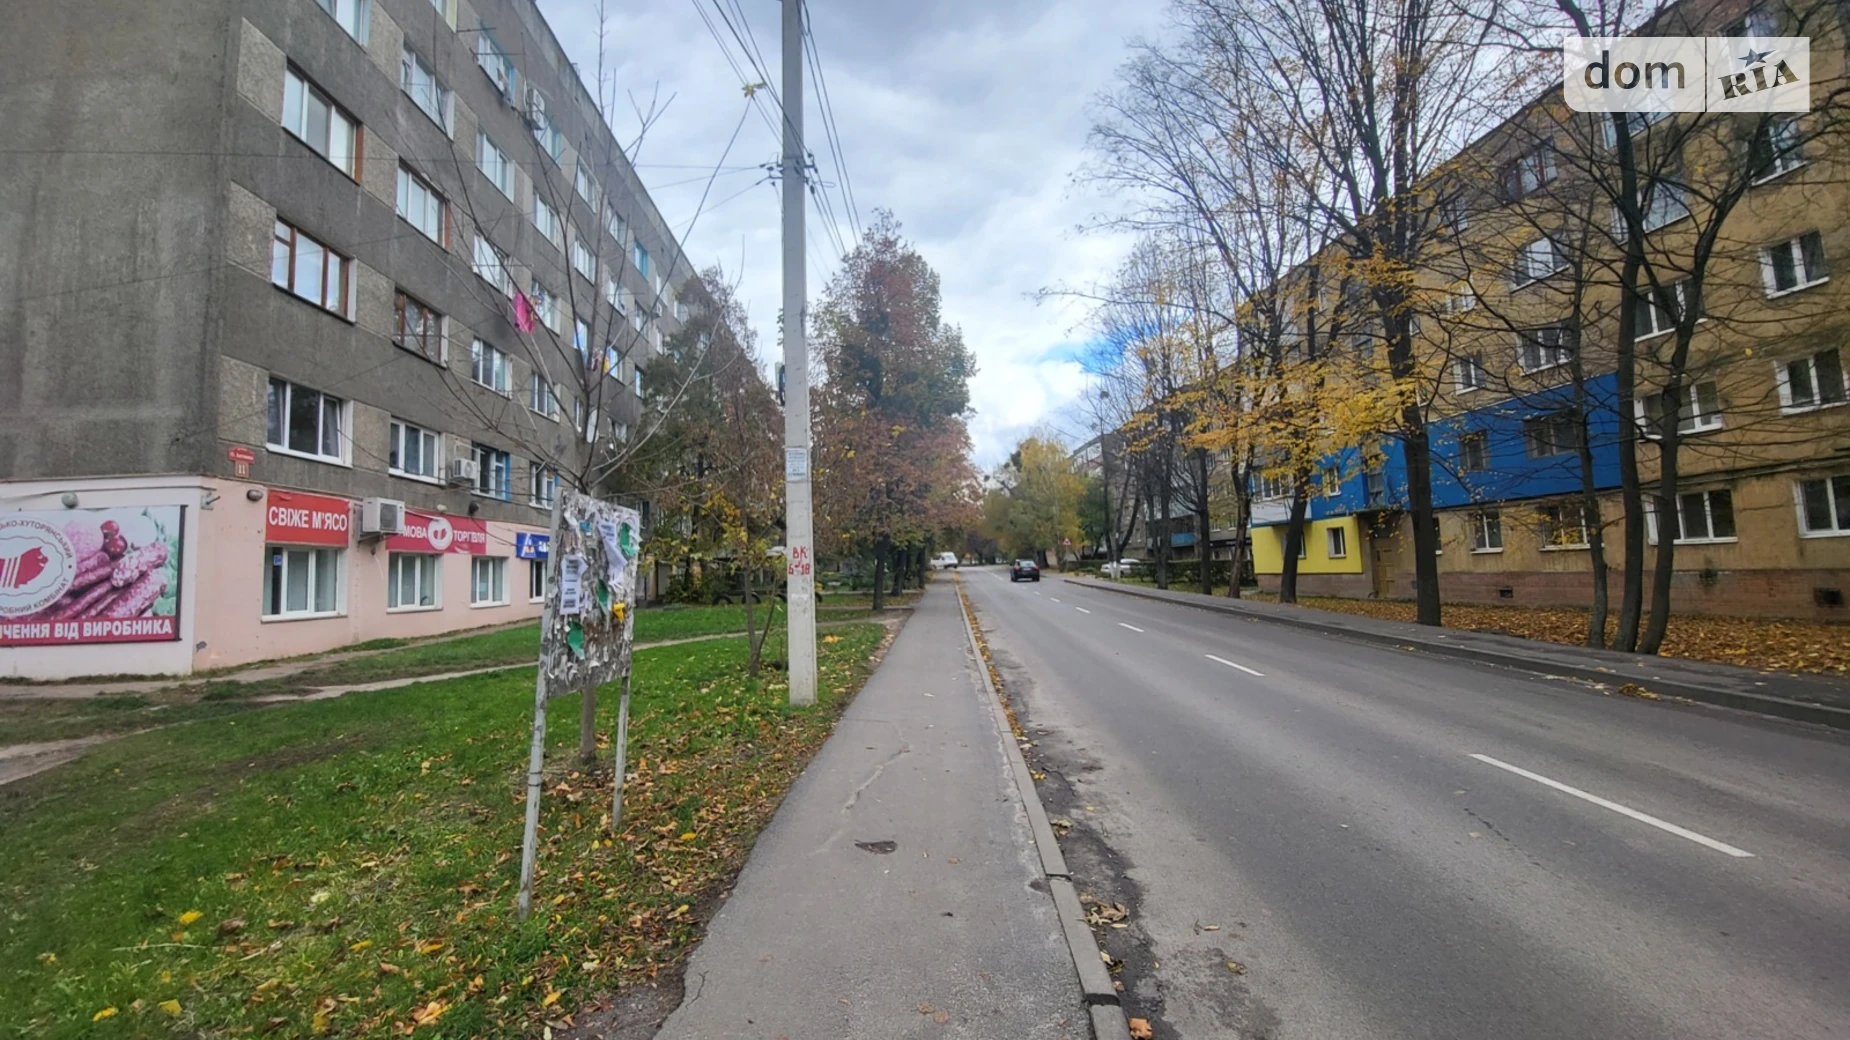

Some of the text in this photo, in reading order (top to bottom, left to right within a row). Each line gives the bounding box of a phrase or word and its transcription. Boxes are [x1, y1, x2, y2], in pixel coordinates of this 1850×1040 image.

[238, 464, 246, 474] 11
[268, 506, 348, 531] СВІЖЕ М'ЯСО
[54, 622, 79, 640] ВІД
[83, 619, 173, 637] ВИРОБНИКА
